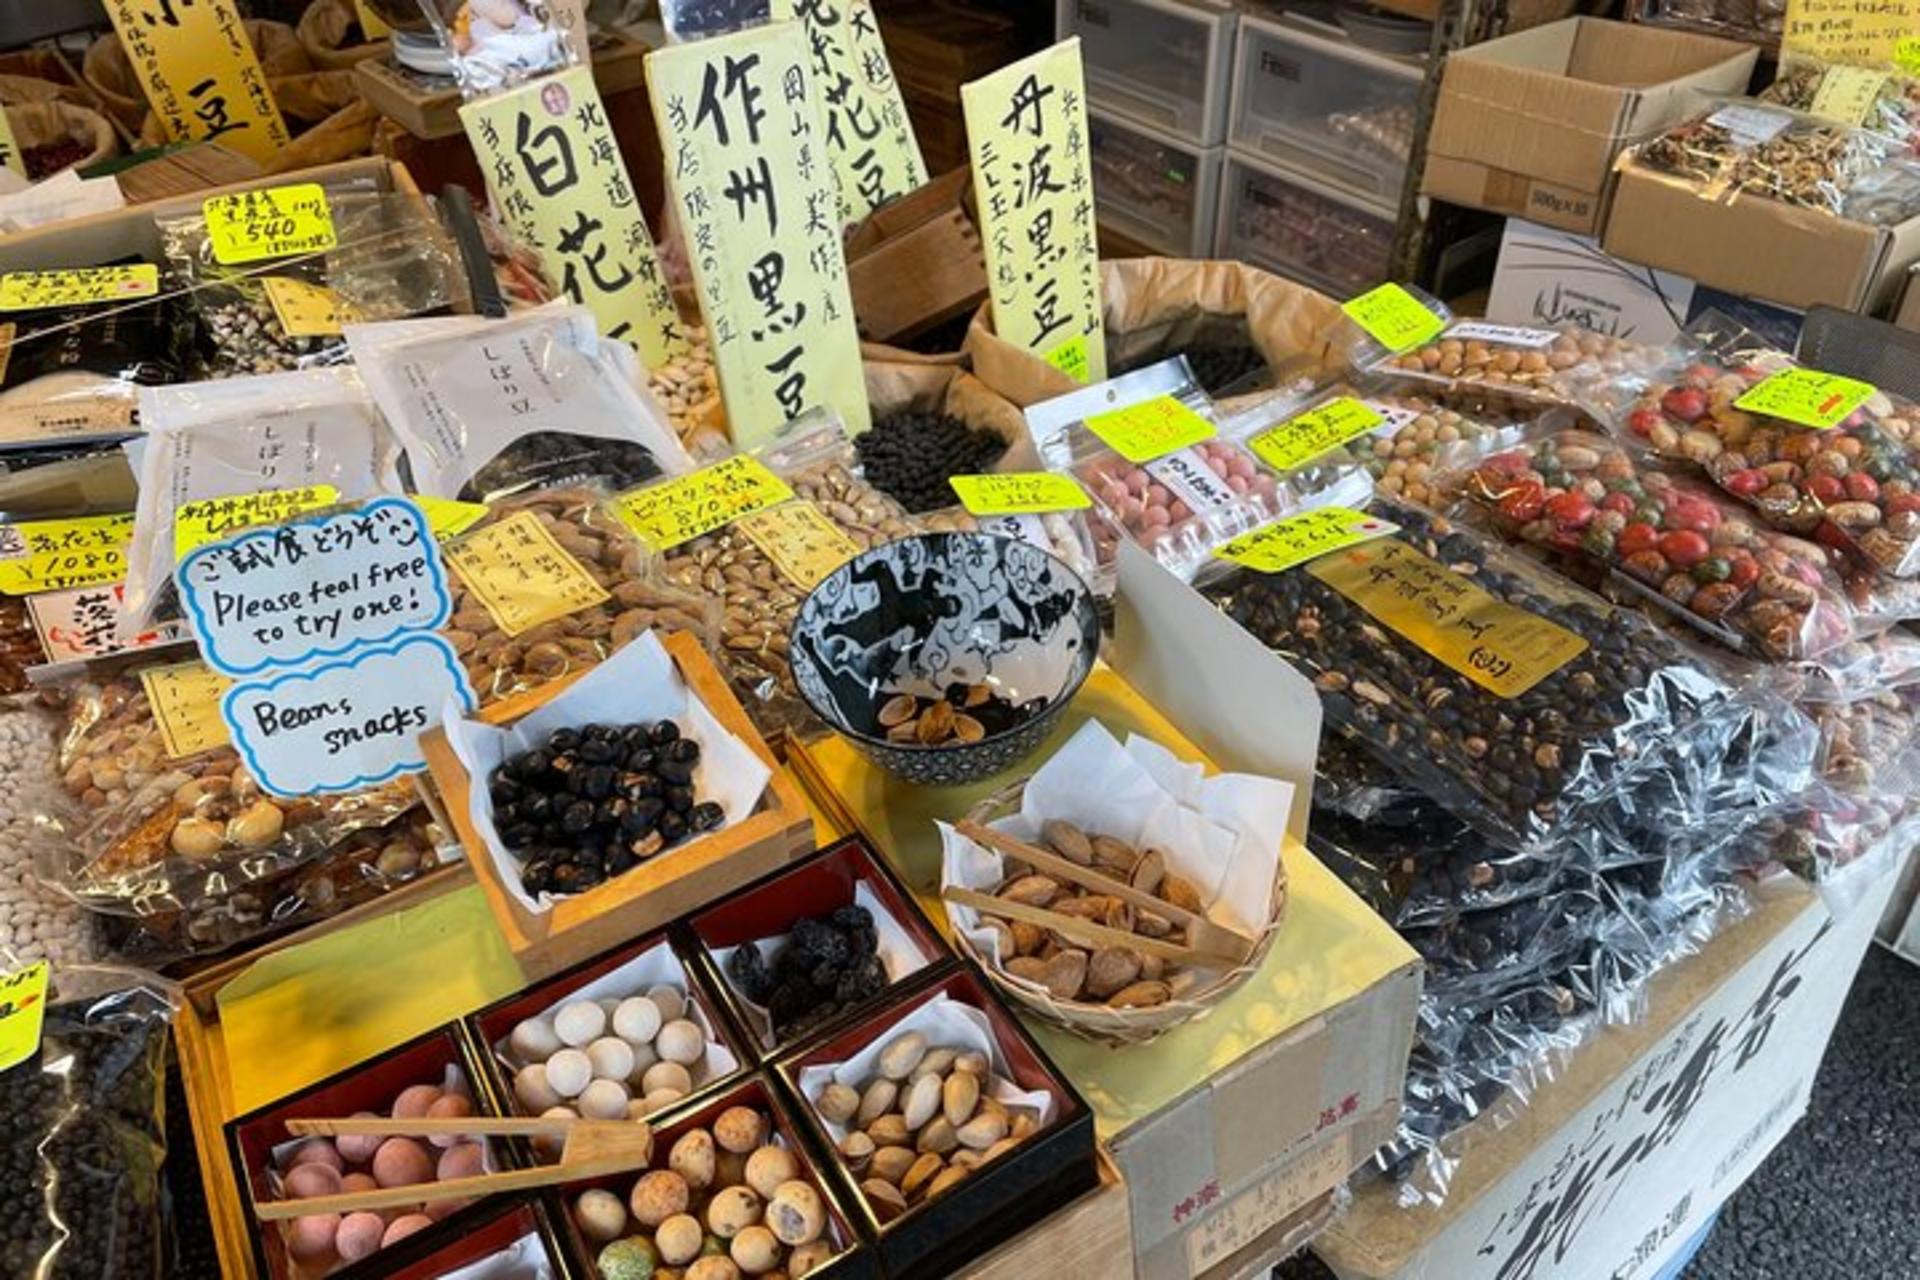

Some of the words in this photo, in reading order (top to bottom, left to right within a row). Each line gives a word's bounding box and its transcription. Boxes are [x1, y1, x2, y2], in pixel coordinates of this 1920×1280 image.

[693, 53, 806, 421] 作州黒豆
[1001, 73, 1074, 348] 丹波黒豆
[258, 425, 286, 494] しぼり
[199, 508, 391, 582] ご試食どうぞ
[213, 589, 302, 627] Please
[367, 556, 427, 589] free
[253, 621, 285, 646] to
[294, 610, 342, 639] try
[352, 588, 420, 622] one!
[253, 699, 354, 738] Beans
[323, 704, 429, 757] snacks
